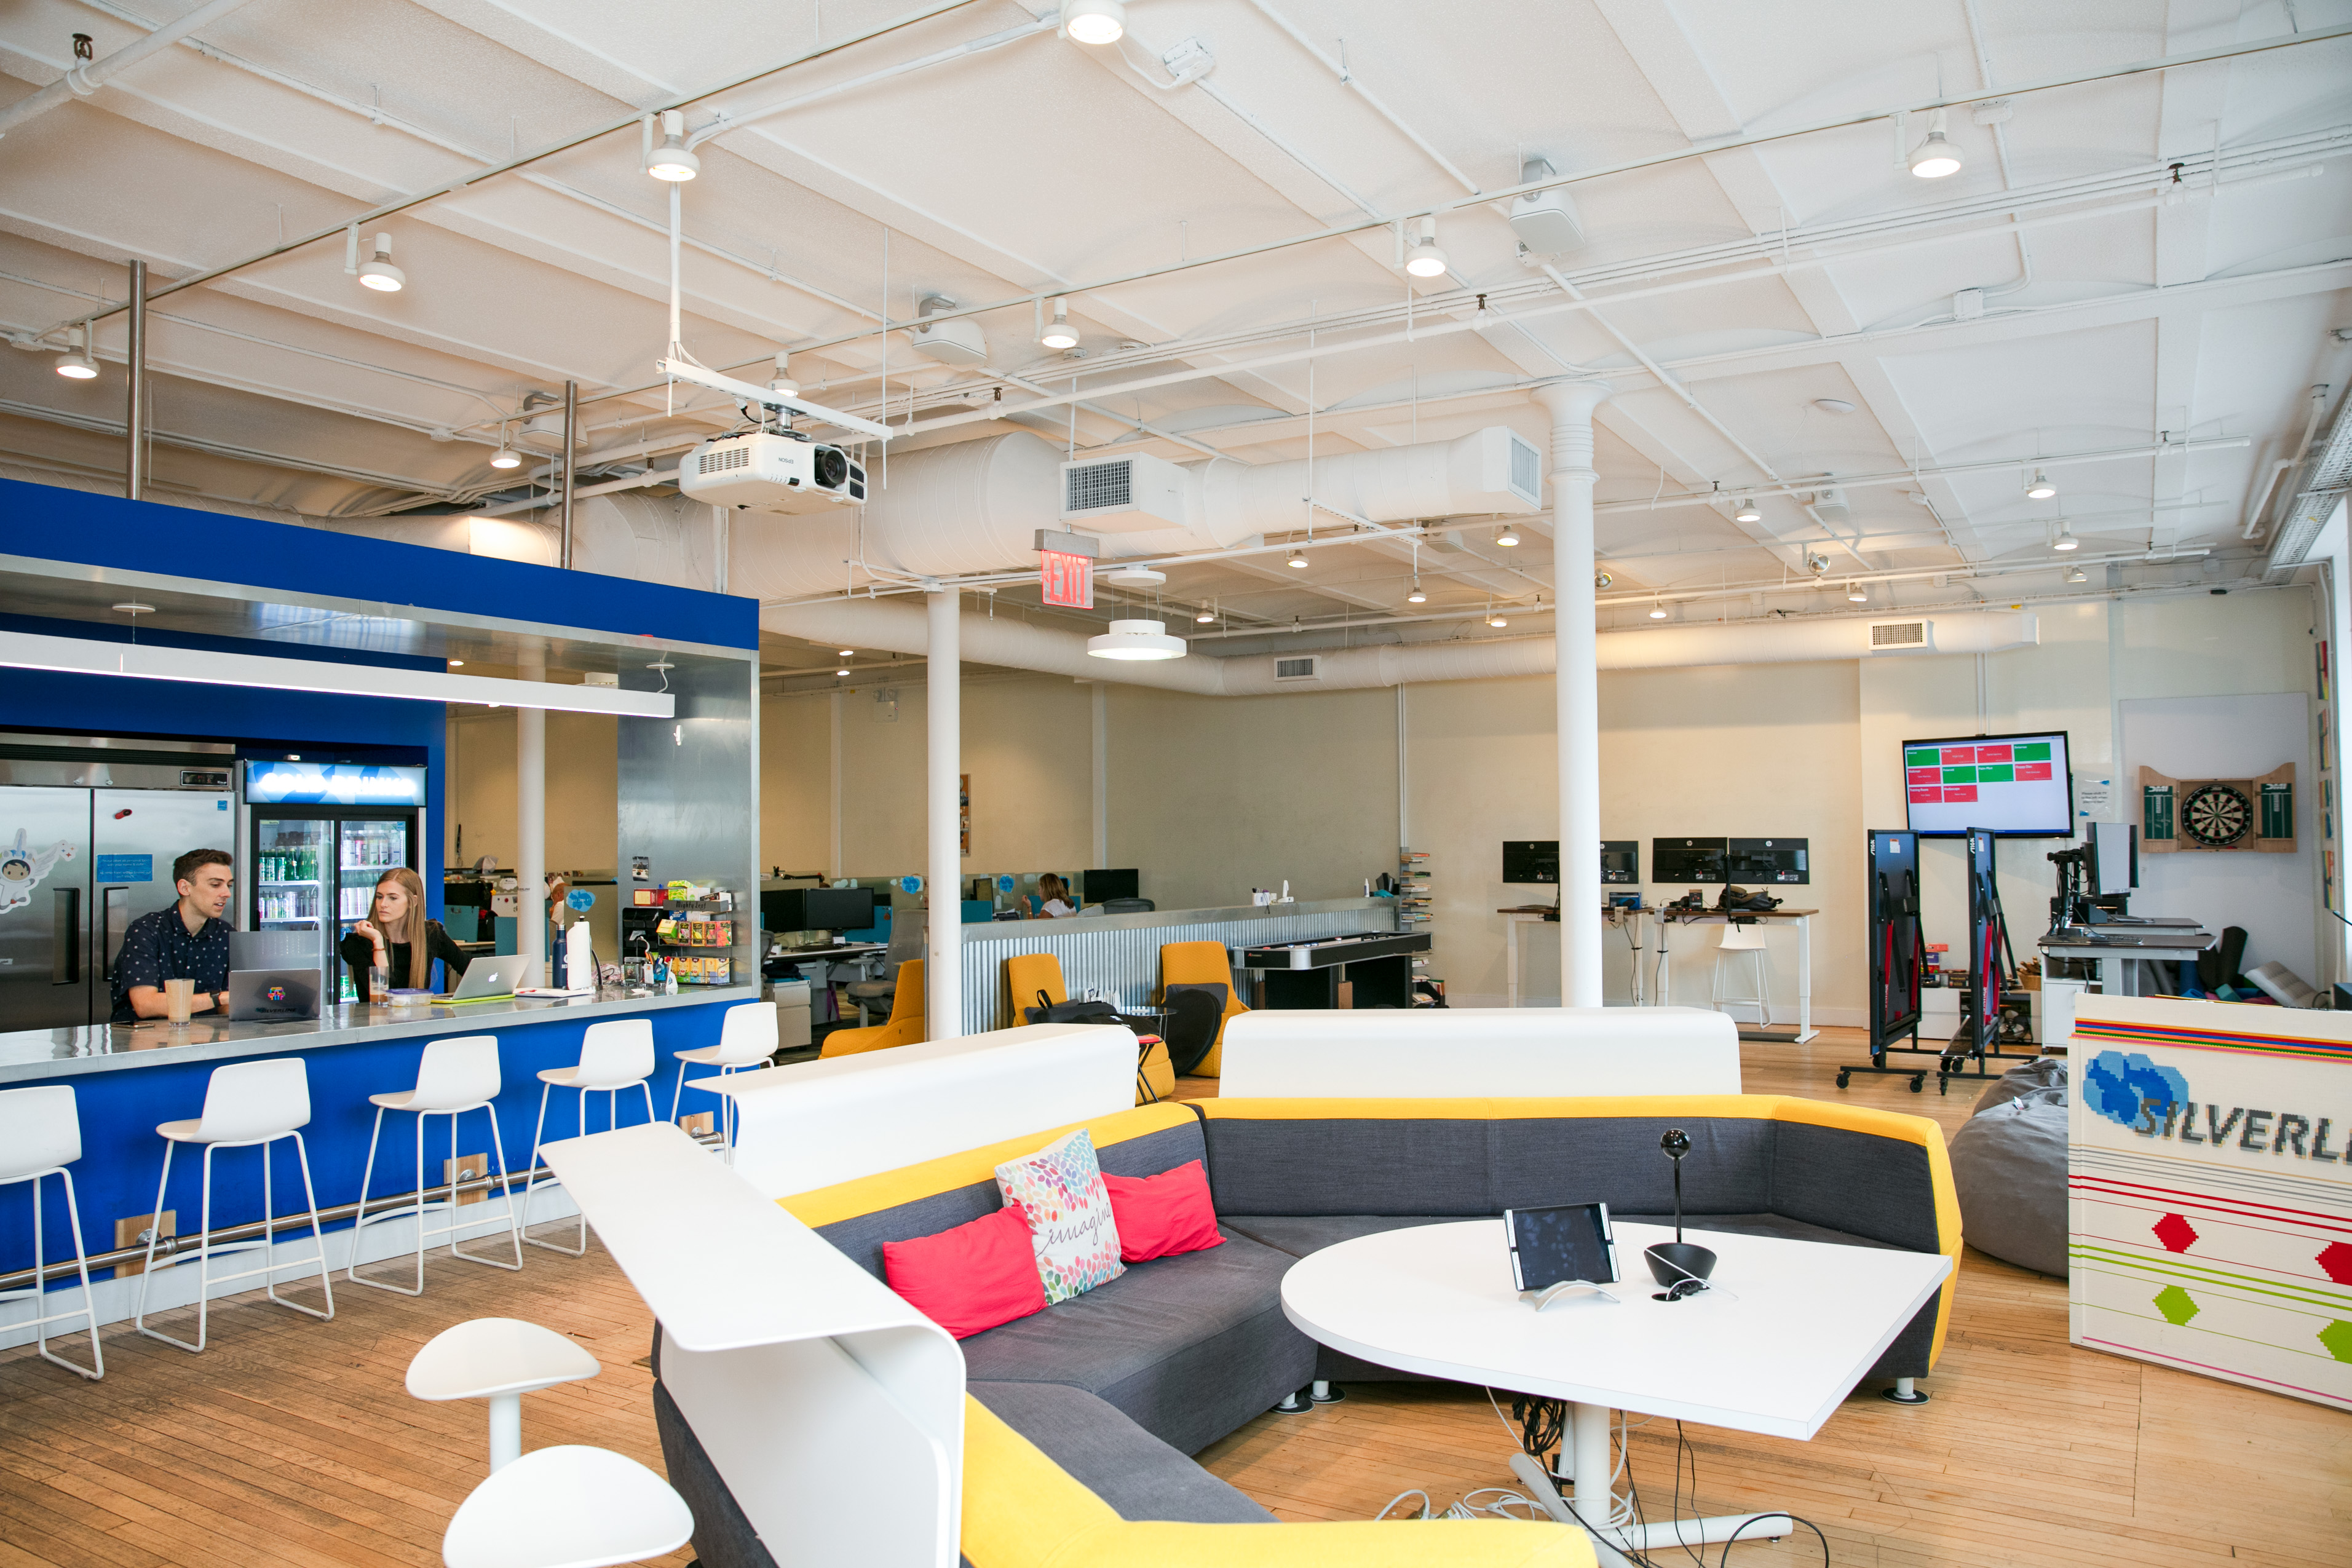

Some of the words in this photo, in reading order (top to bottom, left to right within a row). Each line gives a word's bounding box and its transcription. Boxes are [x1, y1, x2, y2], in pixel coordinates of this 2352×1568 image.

[1049, 552, 1088, 605] EXIT
[676, 901, 694, 909] Mighty
[695, 901, 707, 910] Leaf
[1035, 1202, 1111, 1258] imagine
